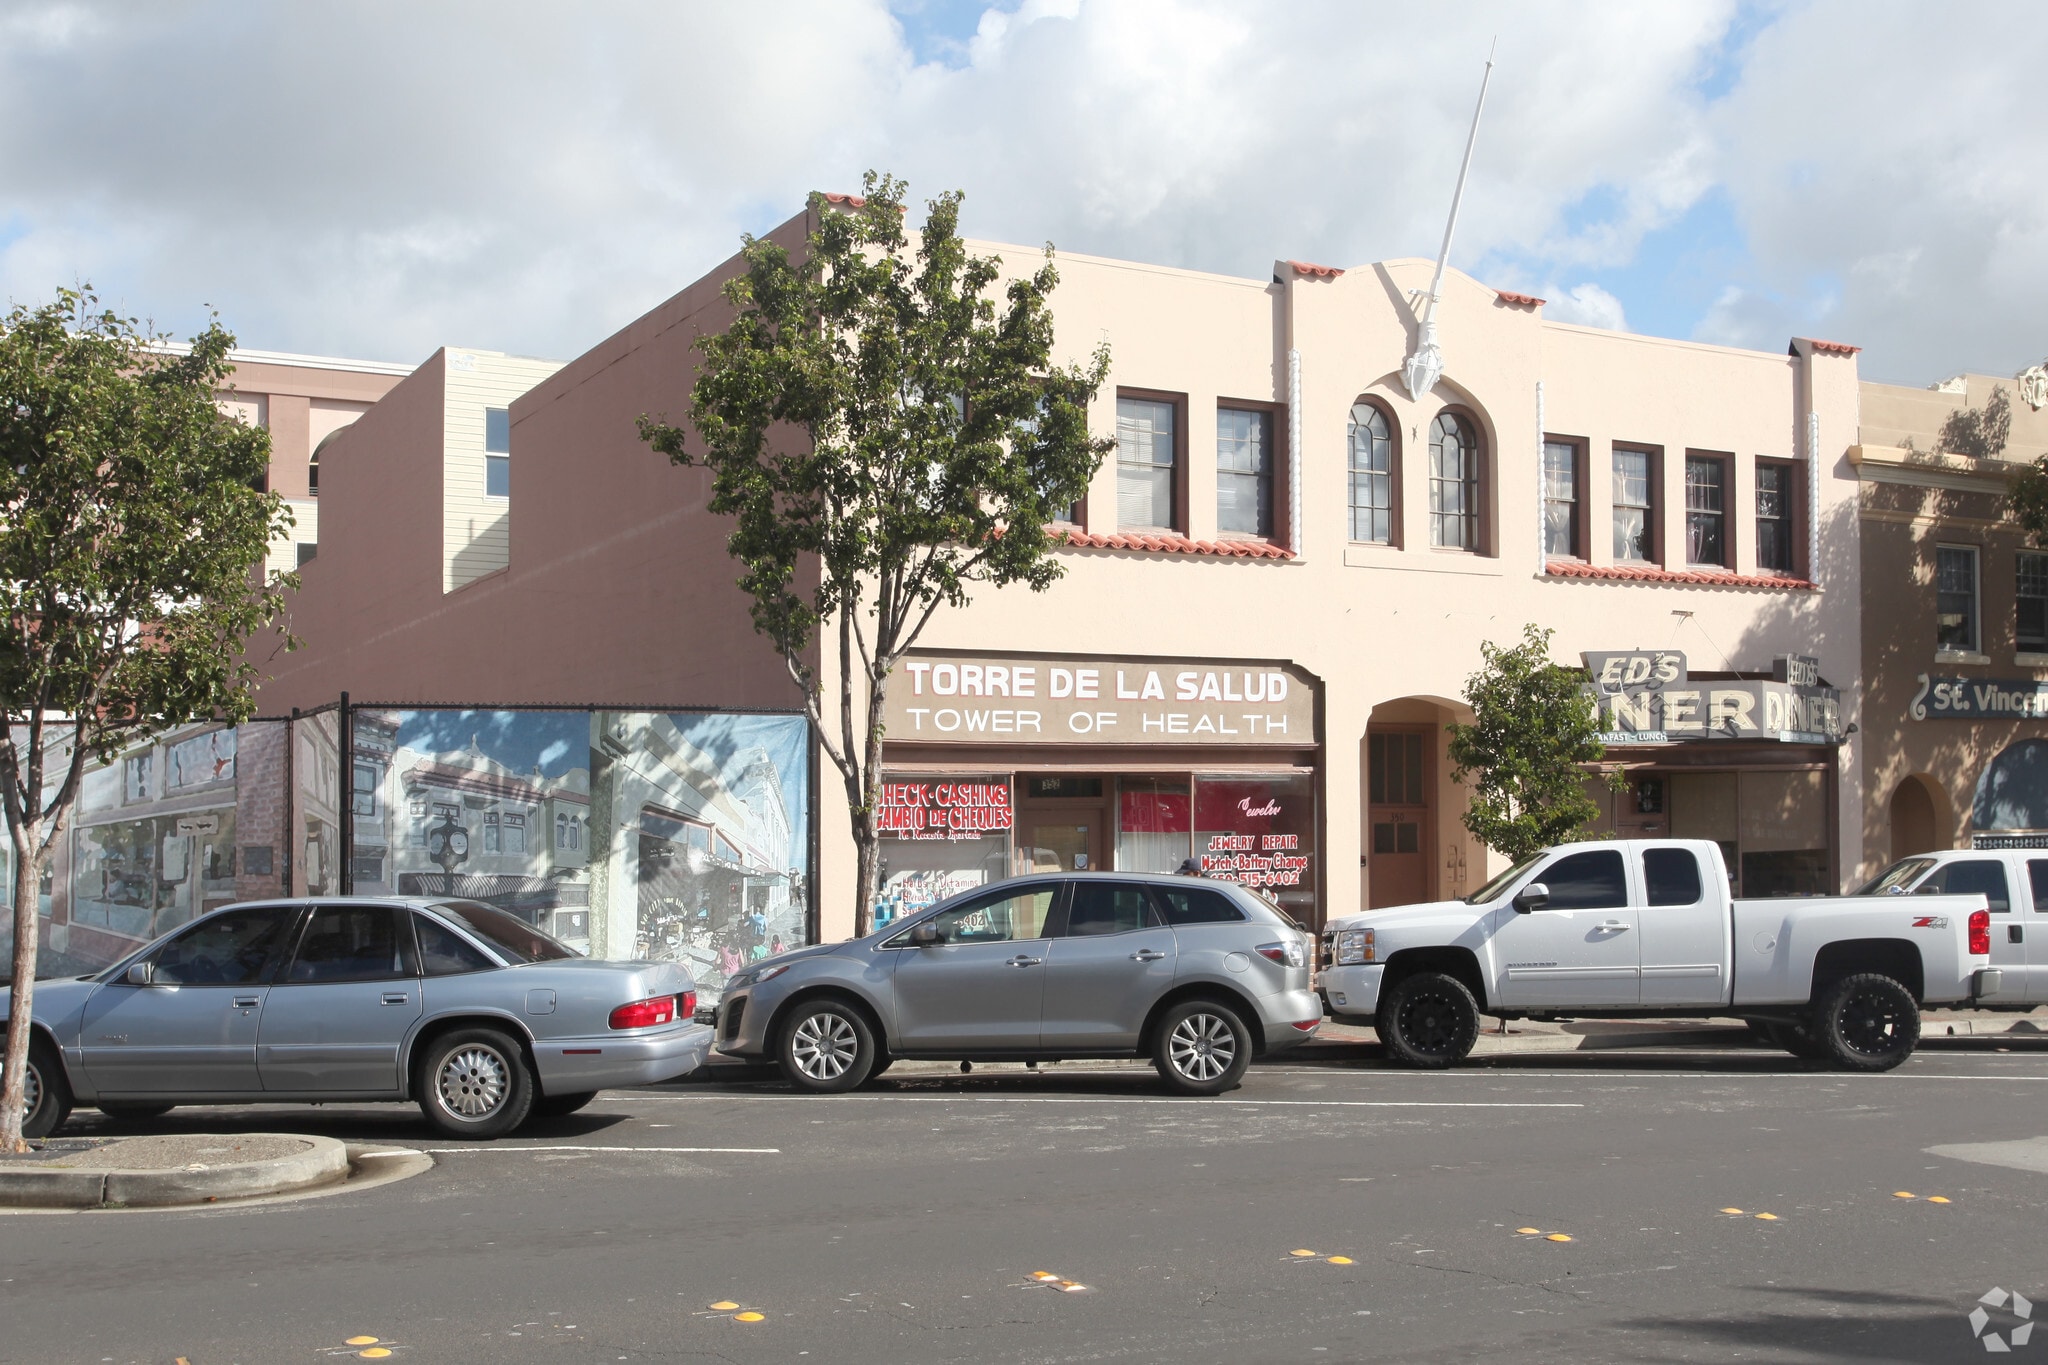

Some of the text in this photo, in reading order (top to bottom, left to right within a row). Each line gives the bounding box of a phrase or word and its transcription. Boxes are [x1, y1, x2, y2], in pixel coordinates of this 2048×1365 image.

[1599, 653, 1682, 685] ED'S
[905, 662, 1288, 702] TORRE DE LA SALUD
[1933, 682, 1970, 710] St.
[905, 708, 1288, 735] TOWER OF HEALTH
[1766, 691, 1841, 735] DINER
[1638, 732, 1667, 741] LUNCH
[878, 783, 1009, 808] HECK CASHING
[930, 809, 947, 827] DE
[949, 807, 1013, 831] CHEQUES
[1208, 834, 1298, 851] JEWELRY REPAIR
[1201, 854, 1232, 871] Watch
[1238, 853, 1273, 872] Battery
[1273, 852, 1308, 874] Change
[902, 875, 980, 889] Herbs Vitamins
